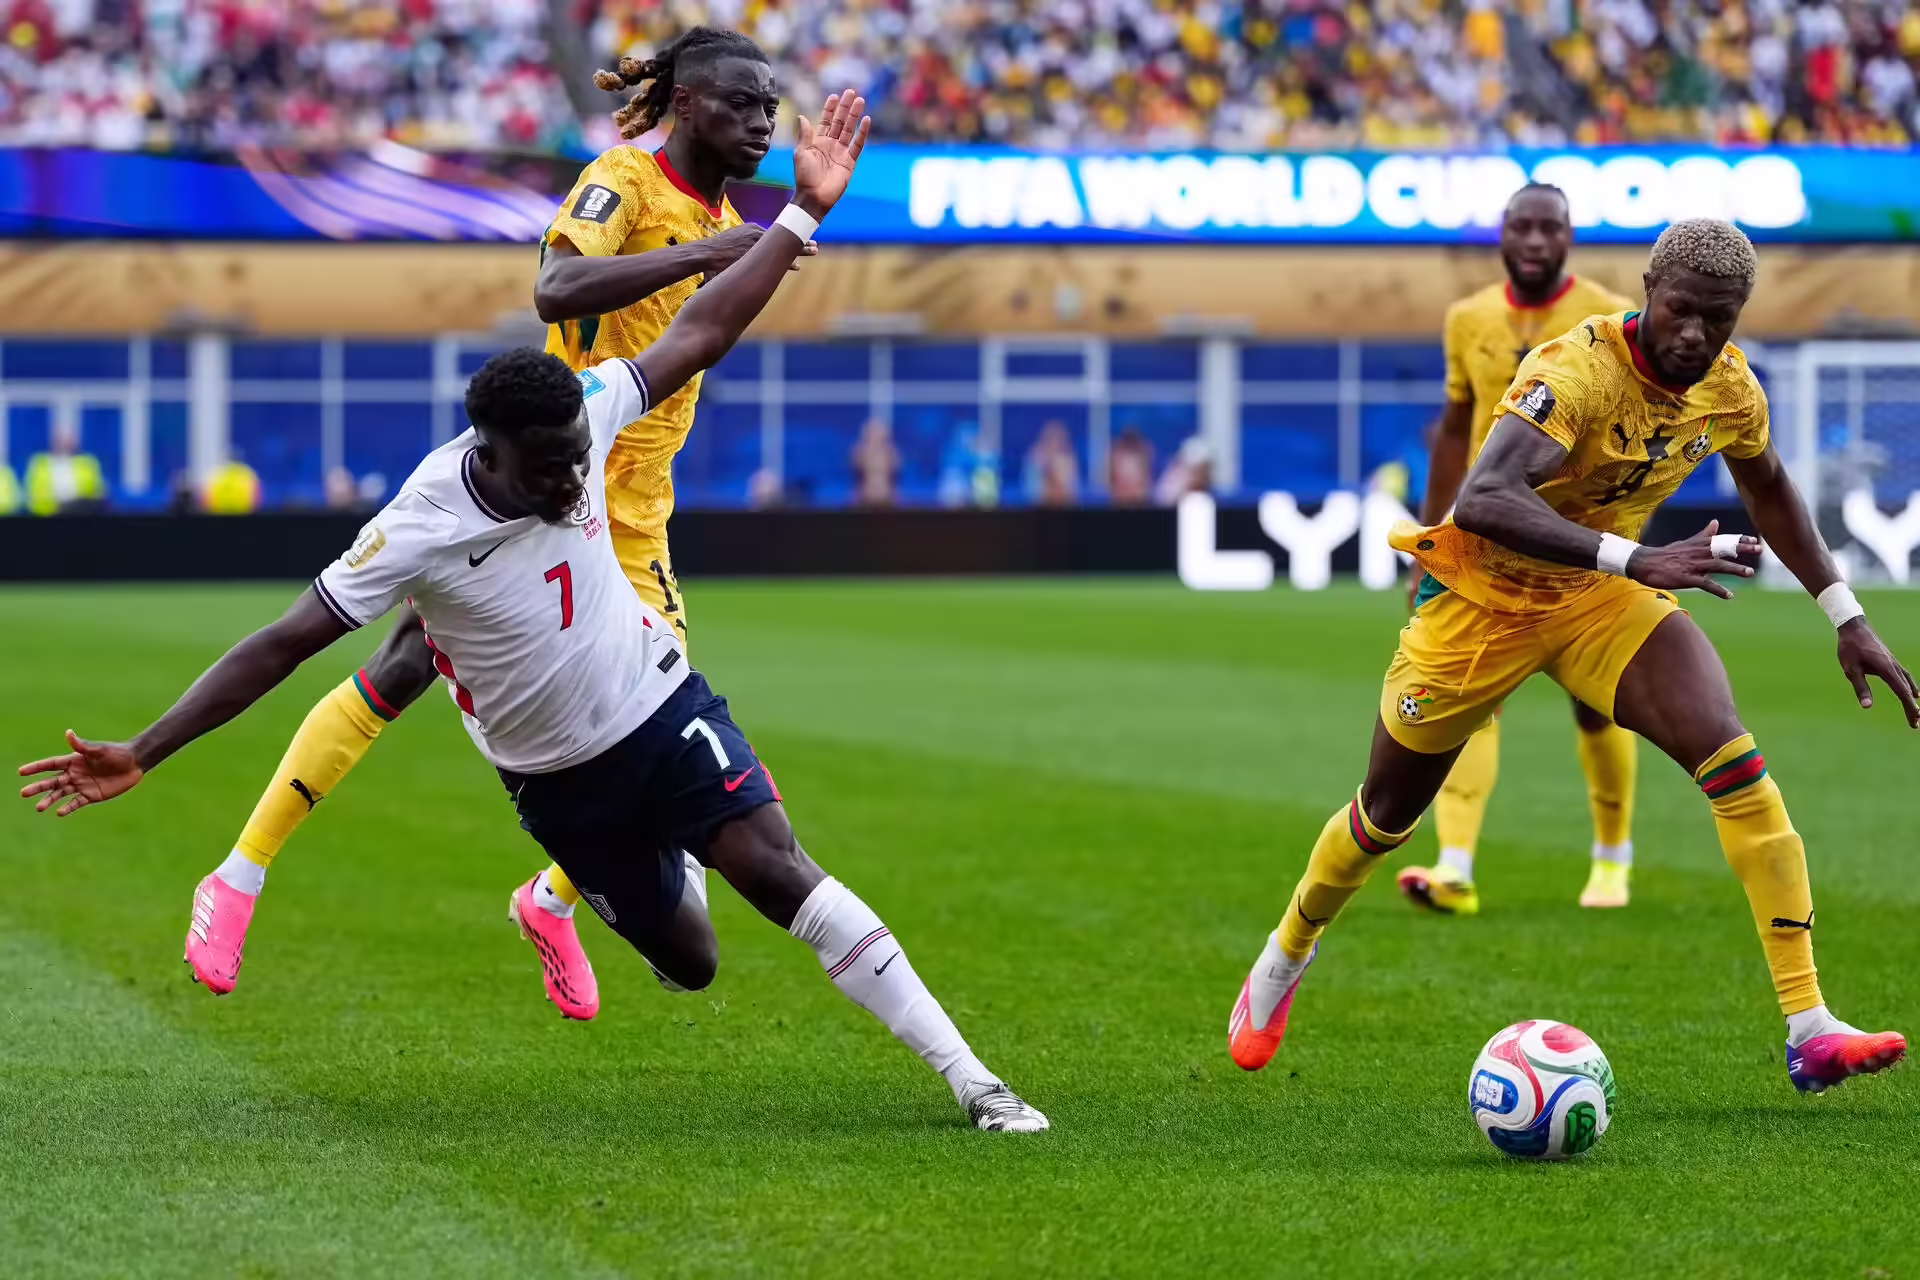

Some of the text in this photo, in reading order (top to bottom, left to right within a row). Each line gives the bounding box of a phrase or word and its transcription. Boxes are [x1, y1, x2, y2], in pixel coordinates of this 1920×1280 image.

[909, 156, 1083, 228] FIFA
[1079, 155, 1364, 229] WORLD
[1367, 155, 1527, 229] CUP
[544, 560, 574, 632] 7
[649, 559, 681, 613] 1
[681, 717, 731, 770] 7
